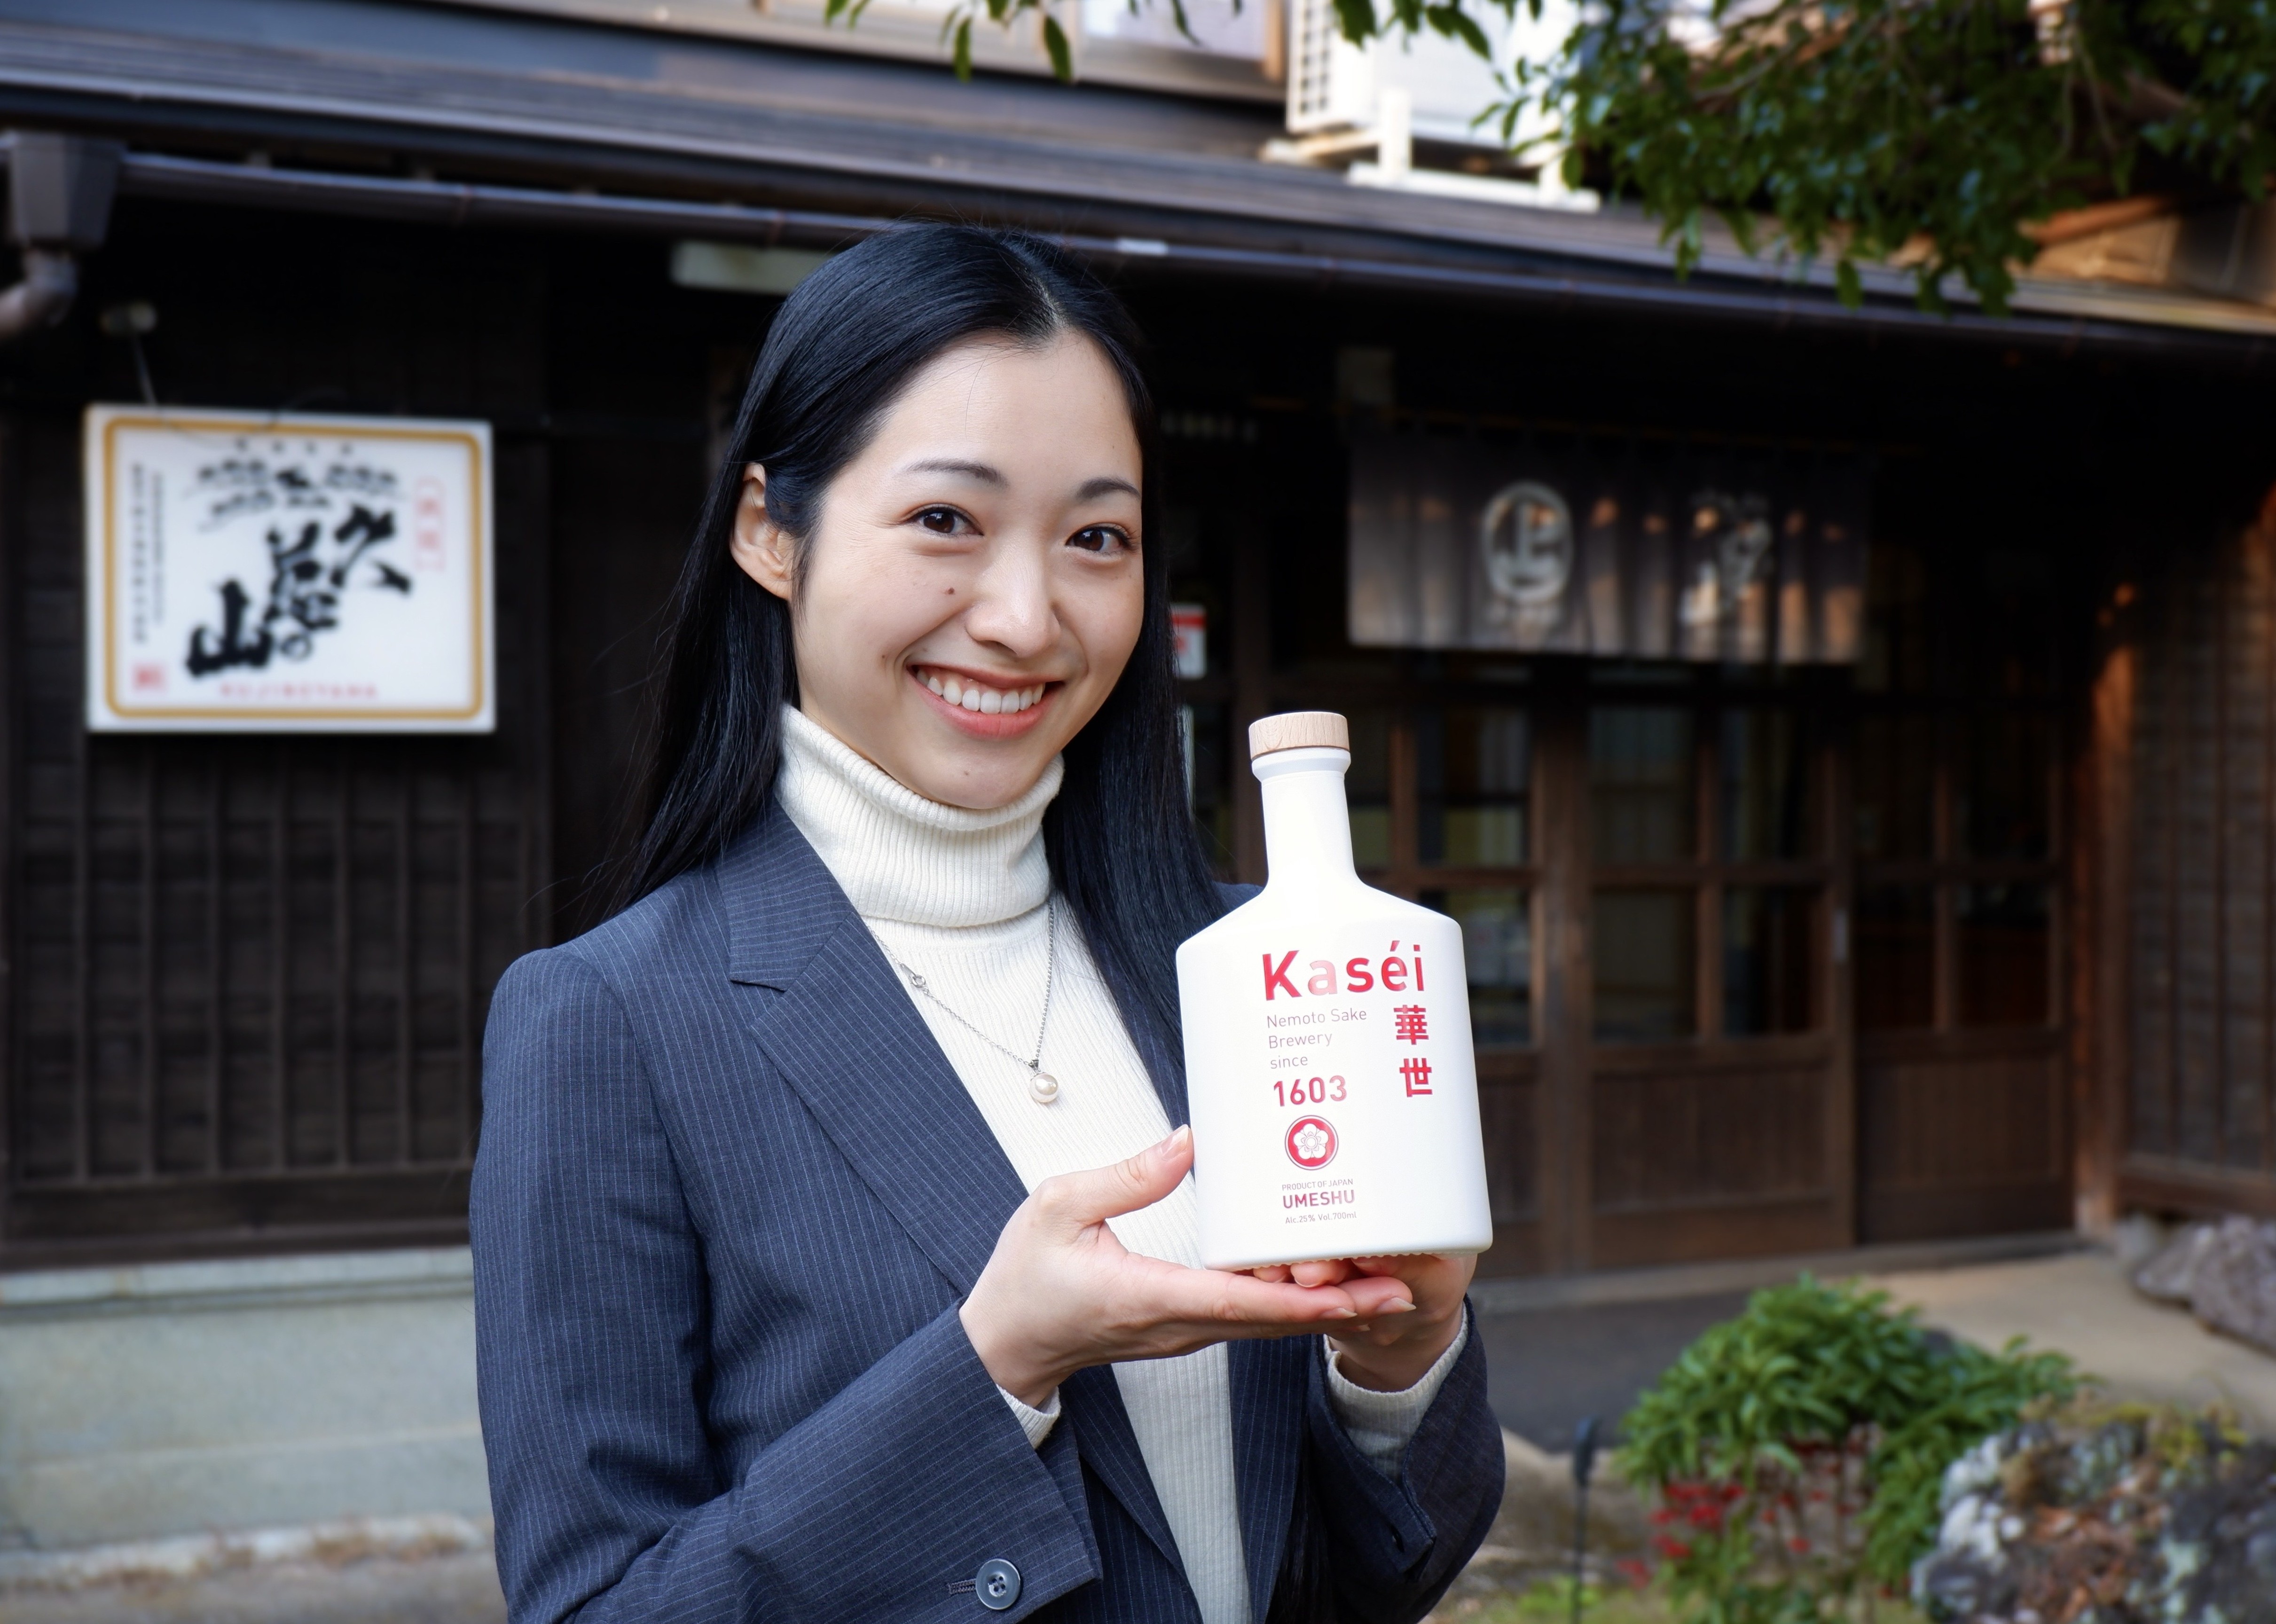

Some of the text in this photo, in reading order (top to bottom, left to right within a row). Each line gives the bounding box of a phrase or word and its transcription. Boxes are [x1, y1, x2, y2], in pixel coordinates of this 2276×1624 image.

[1262, 940, 1425, 1002] Kaséi
[1267, 1008, 1366, 1028] Nemoto Sake
[1269, 1034, 1332, 1049] Brewery
[1393, 1004, 1433, 1098] 華世
[1271, 1055, 1308, 1069] since
[1273, 1075, 1347, 1107] 1603
[1282, 1181, 1316, 1191] PRODUCT
[1328, 1178, 1353, 1187] JAPAN
[1283, 1190, 1355, 1209] UMESHU
[1285, 1211, 1357, 1224] Alc.25% Vol.700ml
